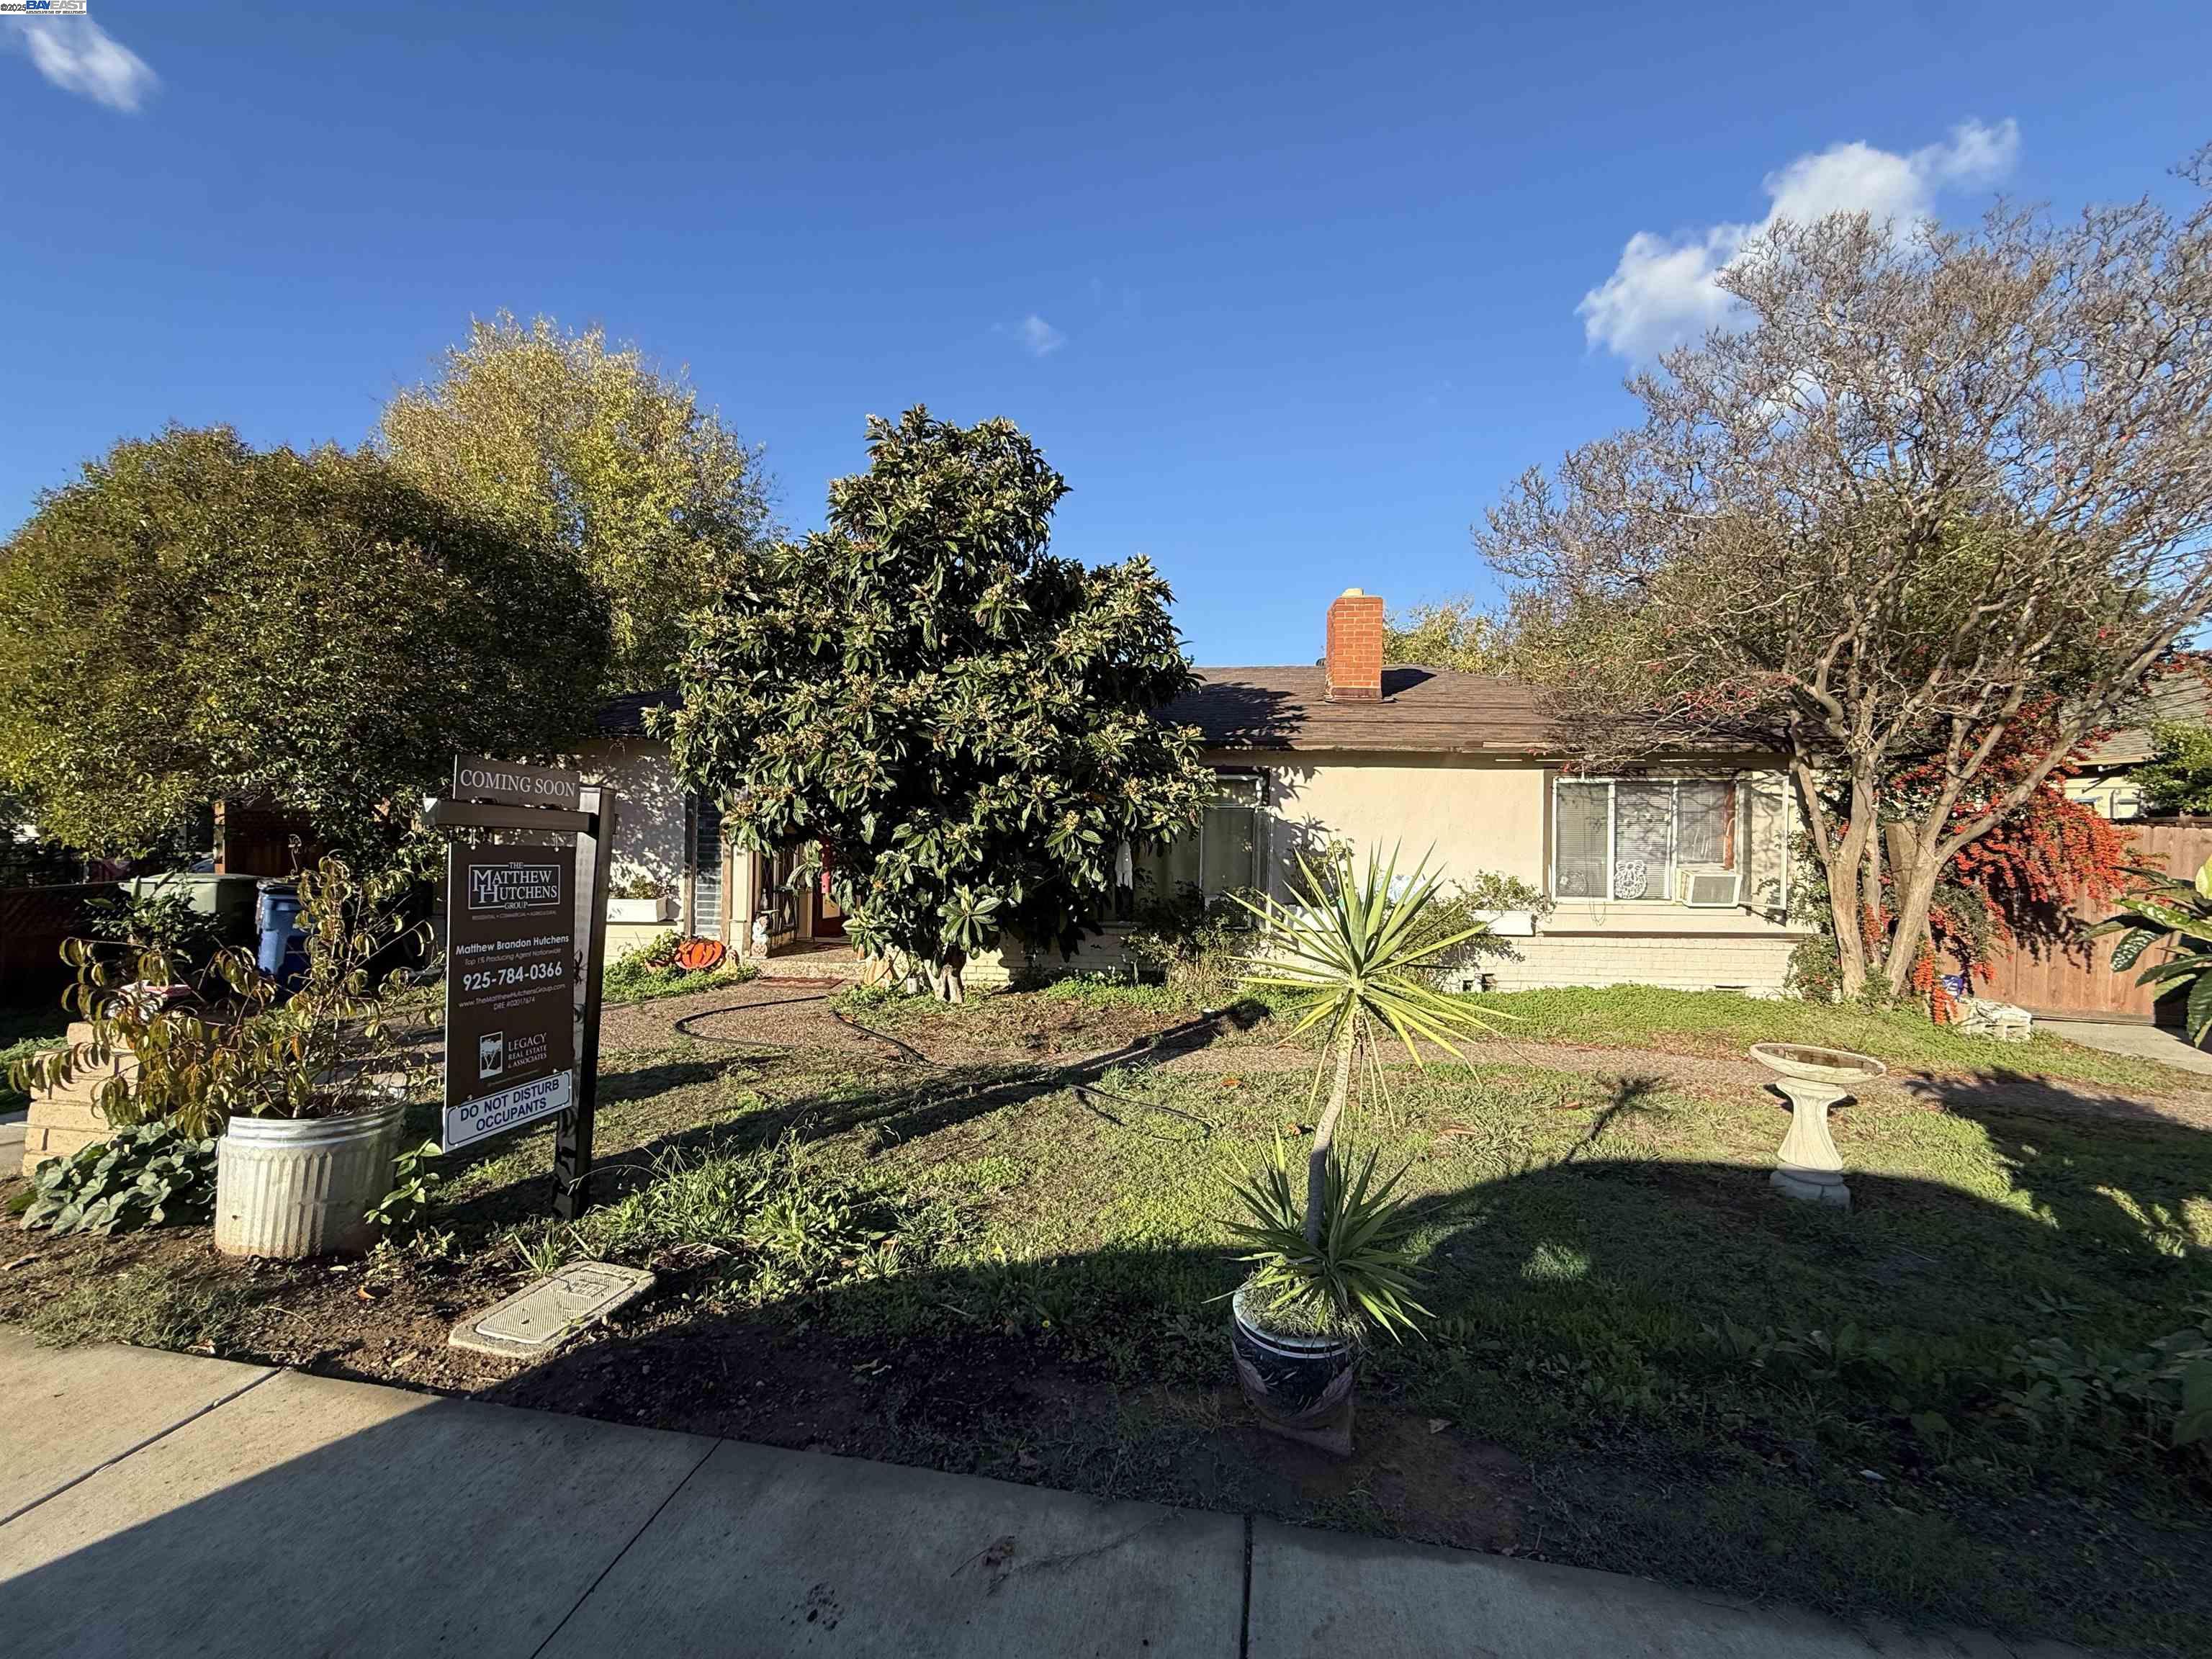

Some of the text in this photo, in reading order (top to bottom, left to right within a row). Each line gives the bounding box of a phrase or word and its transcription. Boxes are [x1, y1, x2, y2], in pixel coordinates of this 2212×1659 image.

[460, 769, 576, 797] COMING SOON
[508, 861, 524, 870] THE
[472, 869, 552, 892] MATTHEW
[478, 884, 558, 904] HUTCHENS
[504, 901, 529, 910] GROUP
[456, 935, 570, 956] Matthew Brandon Hutchens
[485, 953, 514, 963] Producing
[515, 950, 531, 961] Agent
[462, 961, 563, 992] 925-784-0366
[508, 1032, 547, 1051] LEGACY
[508, 1044, 547, 1061] REAL ESTATE
[513, 1052, 547, 1068] ASSOCIATES
[460, 1079, 559, 1122] DO NOT DISTURB
[476, 1098, 547, 1131] OCCUPANTS
